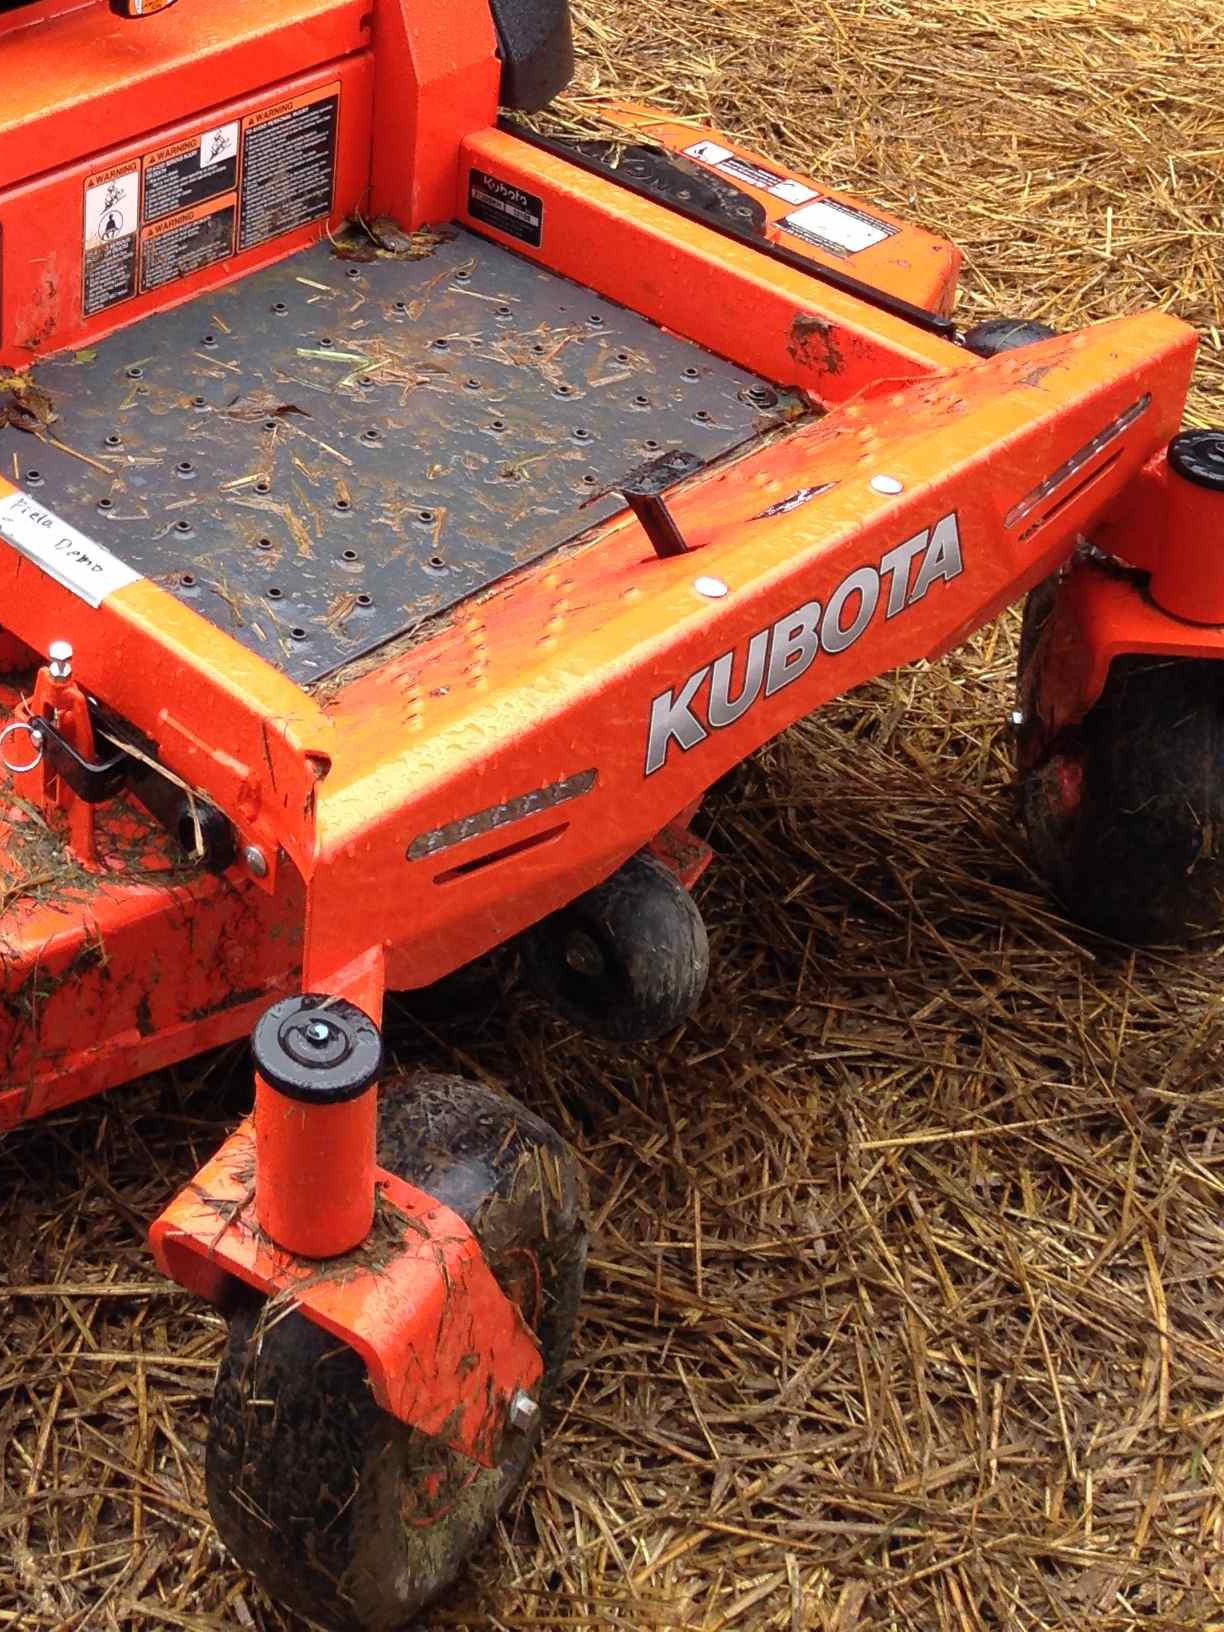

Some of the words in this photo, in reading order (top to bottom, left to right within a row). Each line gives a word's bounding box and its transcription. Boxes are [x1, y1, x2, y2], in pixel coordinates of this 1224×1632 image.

[255, 101, 294, 123] WARNING
[156, 139, 198, 162] WARNING
[483, 175, 528, 206] Kubota
[154, 211, 195, 233] WARNING
[644, 510, 964, 779] KUBOTA
